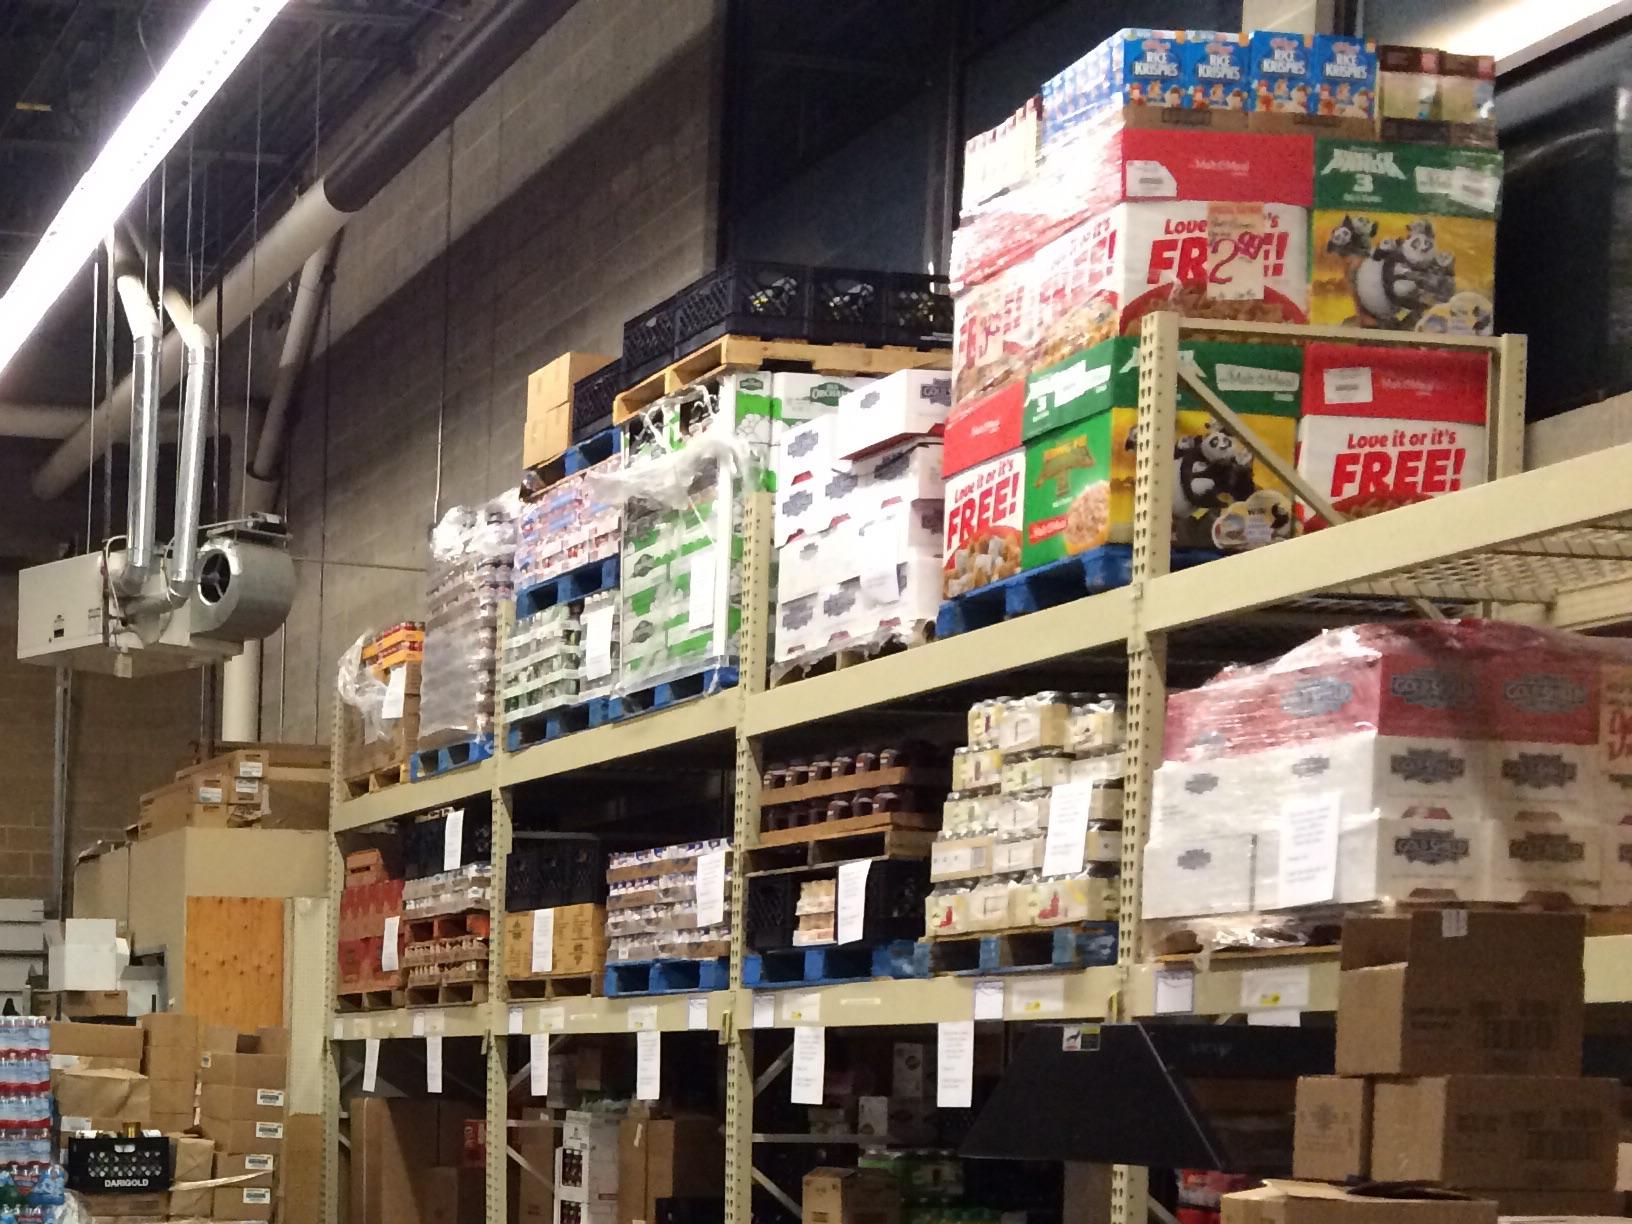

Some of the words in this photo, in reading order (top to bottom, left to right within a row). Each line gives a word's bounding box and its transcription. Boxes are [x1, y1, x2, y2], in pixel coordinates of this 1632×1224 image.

[1353, 174, 1373, 192] 3
[1164, 219, 1207, 235] Love
[1348, 432, 1389, 449] Love
[1394, 429, 1407, 447] it
[1411, 431, 1428, 447] or
[1431, 428, 1457, 445] it's
[955, 480, 974, 503] Love
[977, 475, 984, 489] it
[986, 470, 996, 483] or
[999, 458, 1013, 477] it's
[1330, 448, 1466, 497] FREE!
[947, 472, 1020, 550] FREE!
[104, 1178, 149, 1188] DARIGOLD
